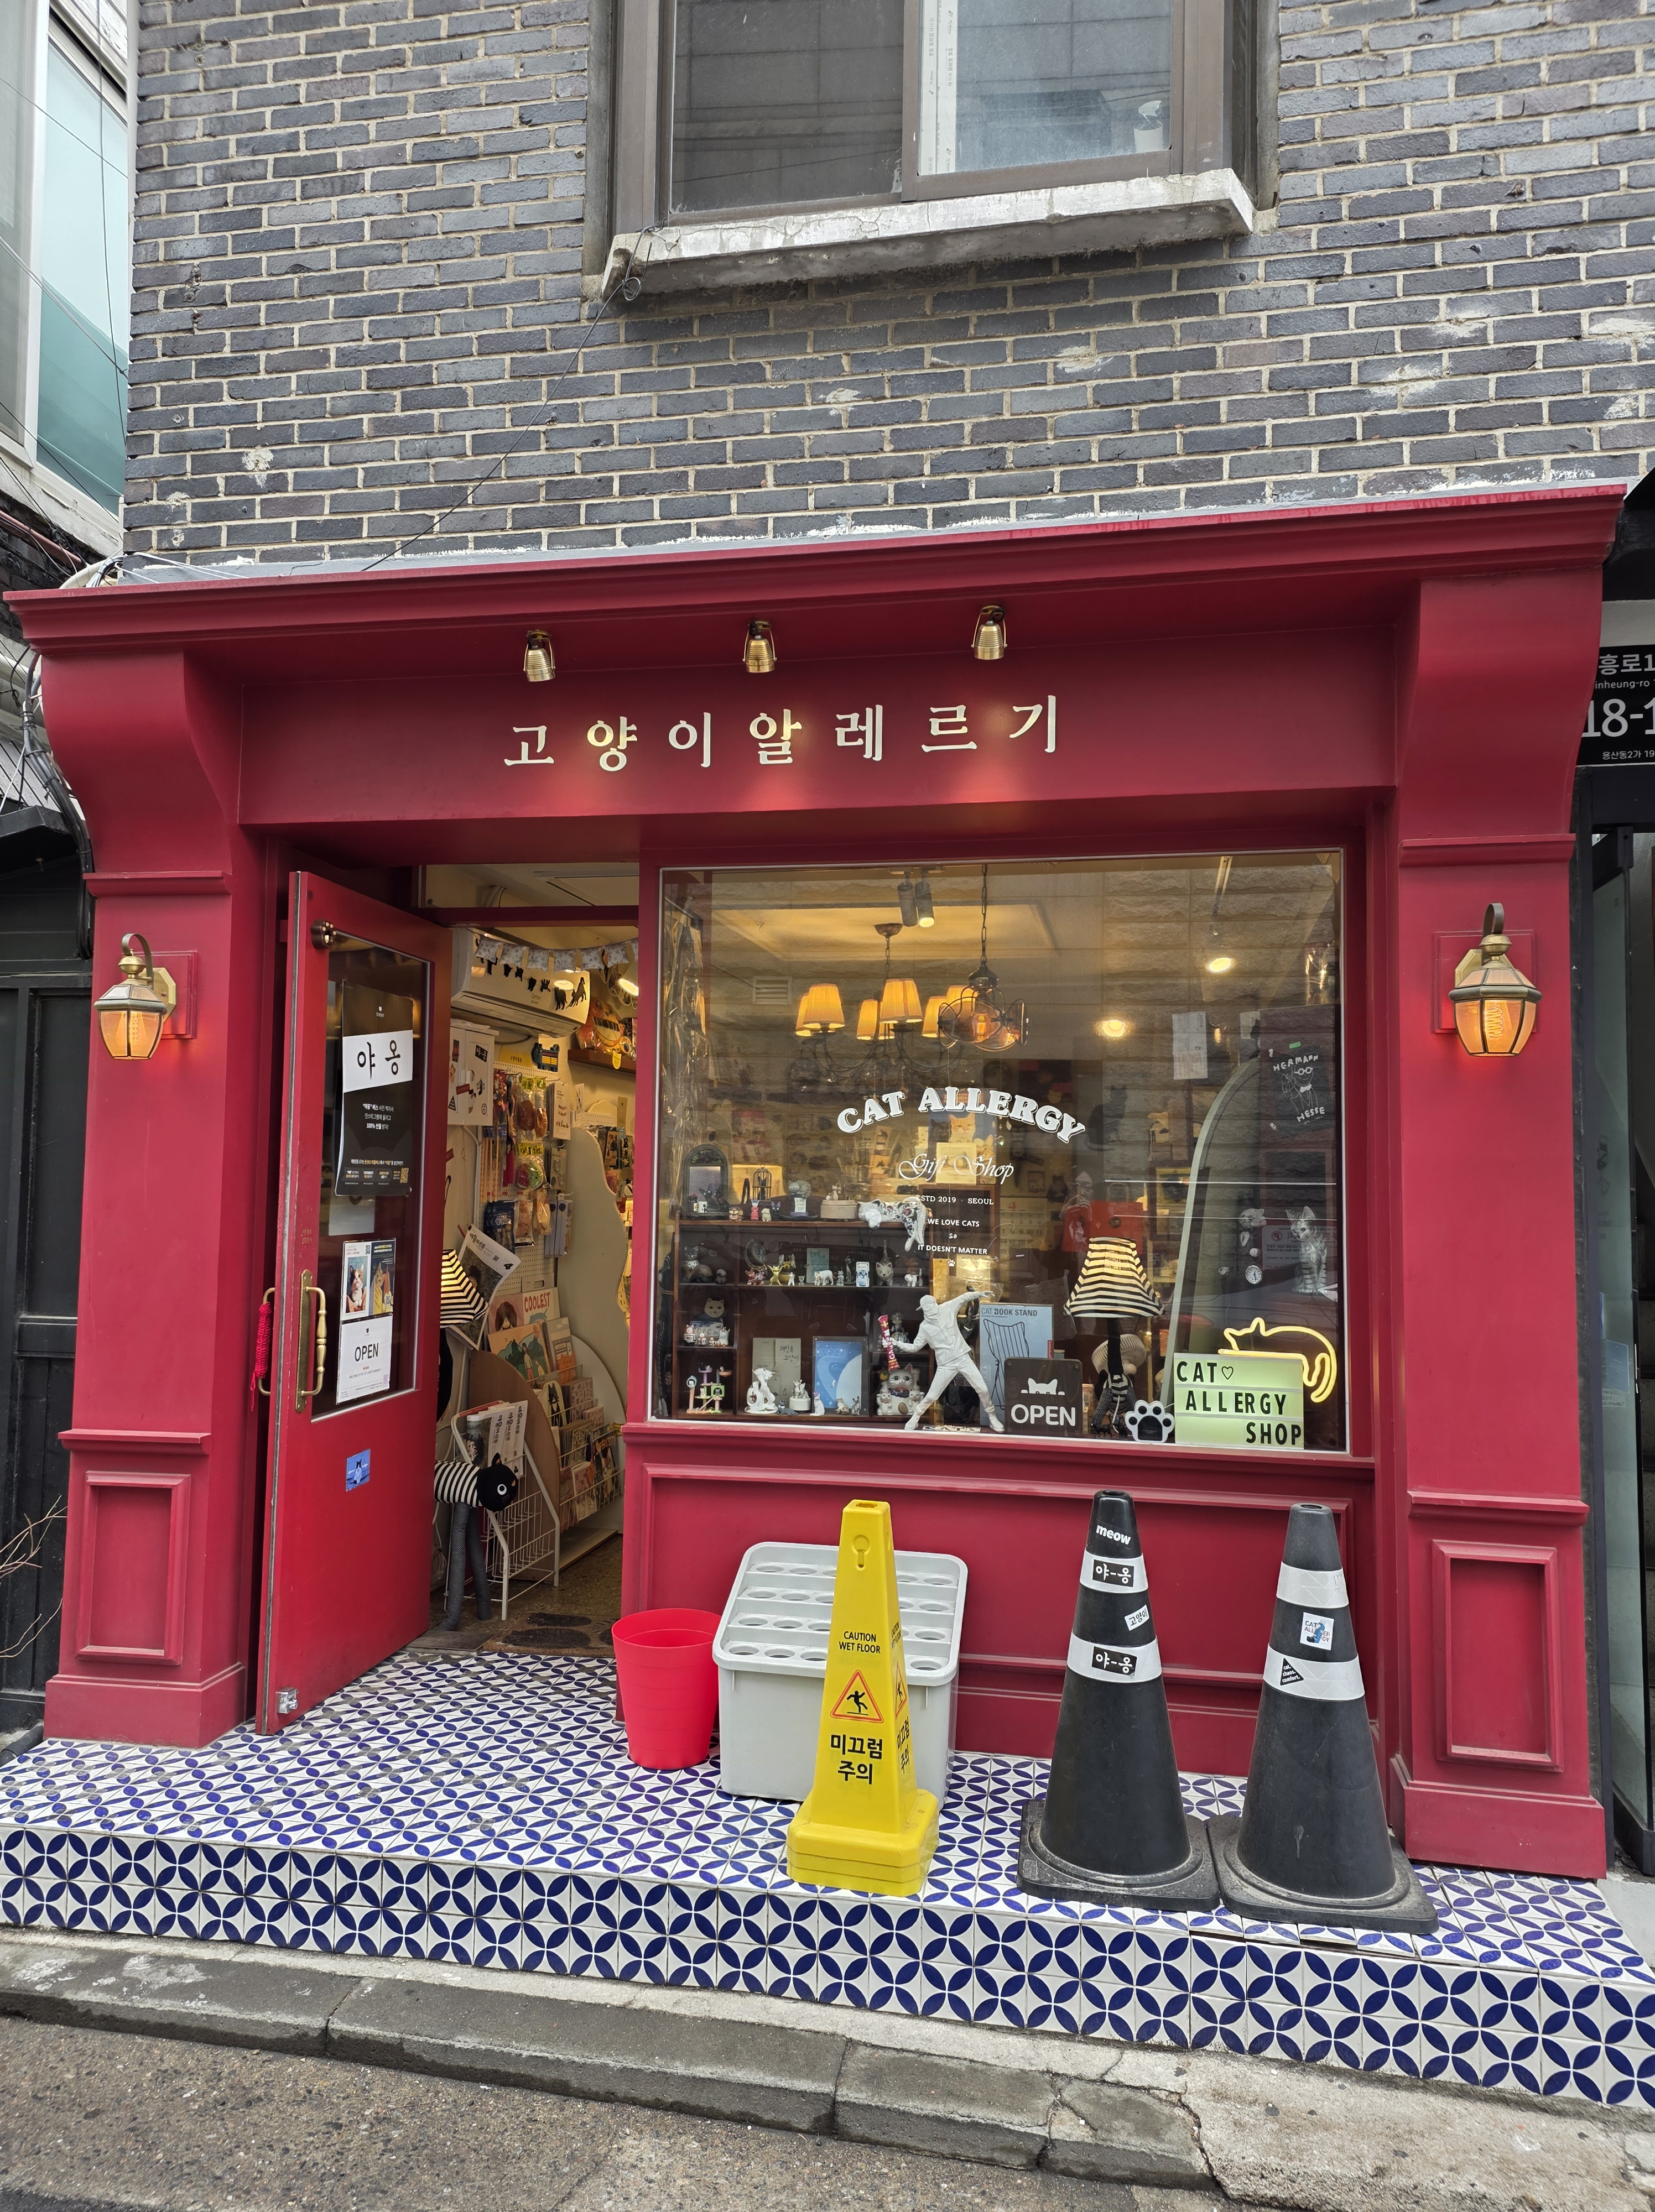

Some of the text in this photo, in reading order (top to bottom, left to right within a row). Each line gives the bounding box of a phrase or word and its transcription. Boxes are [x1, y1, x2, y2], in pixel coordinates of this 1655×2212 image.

[1273, 1055, 1318, 1071] HERMANN
[837, 1087, 1086, 1144] CAT ALLERGY
[1297, 1107, 1325, 1122] HESSE
[899, 1153, 1014, 1185] Gift Shop
[524, 1292, 550, 1313] COOLEST
[355, 1343, 378, 1361] OPEN
[784, 1354, 799, 1363] 고양이
[1177, 1361, 1217, 1383] CAT
[1186, 1390, 1287, 1415] ALLERGY
[1011, 1403, 1076, 1427] OPEN
[1246, 1422, 1301, 1446] SHOP
[1096, 1525, 1131, 1545] meow
[1095, 1563, 1131, 1584] 야-옹
[1128, 1608, 1148, 1626] 고양이
[844, 1631, 876, 1642] CAUTION
[839, 1641, 881, 1654] WET FLOOR
[1096, 1651, 1133, 1673] 야-옹
[1282, 1674, 1300, 1683] comfort.
[897, 1716, 910, 1751] 미끄럼
[830, 1734, 883, 1760] 미끄럼
[901, 1744, 910, 1774] 주의
[837, 1760, 873, 1785] 주의
